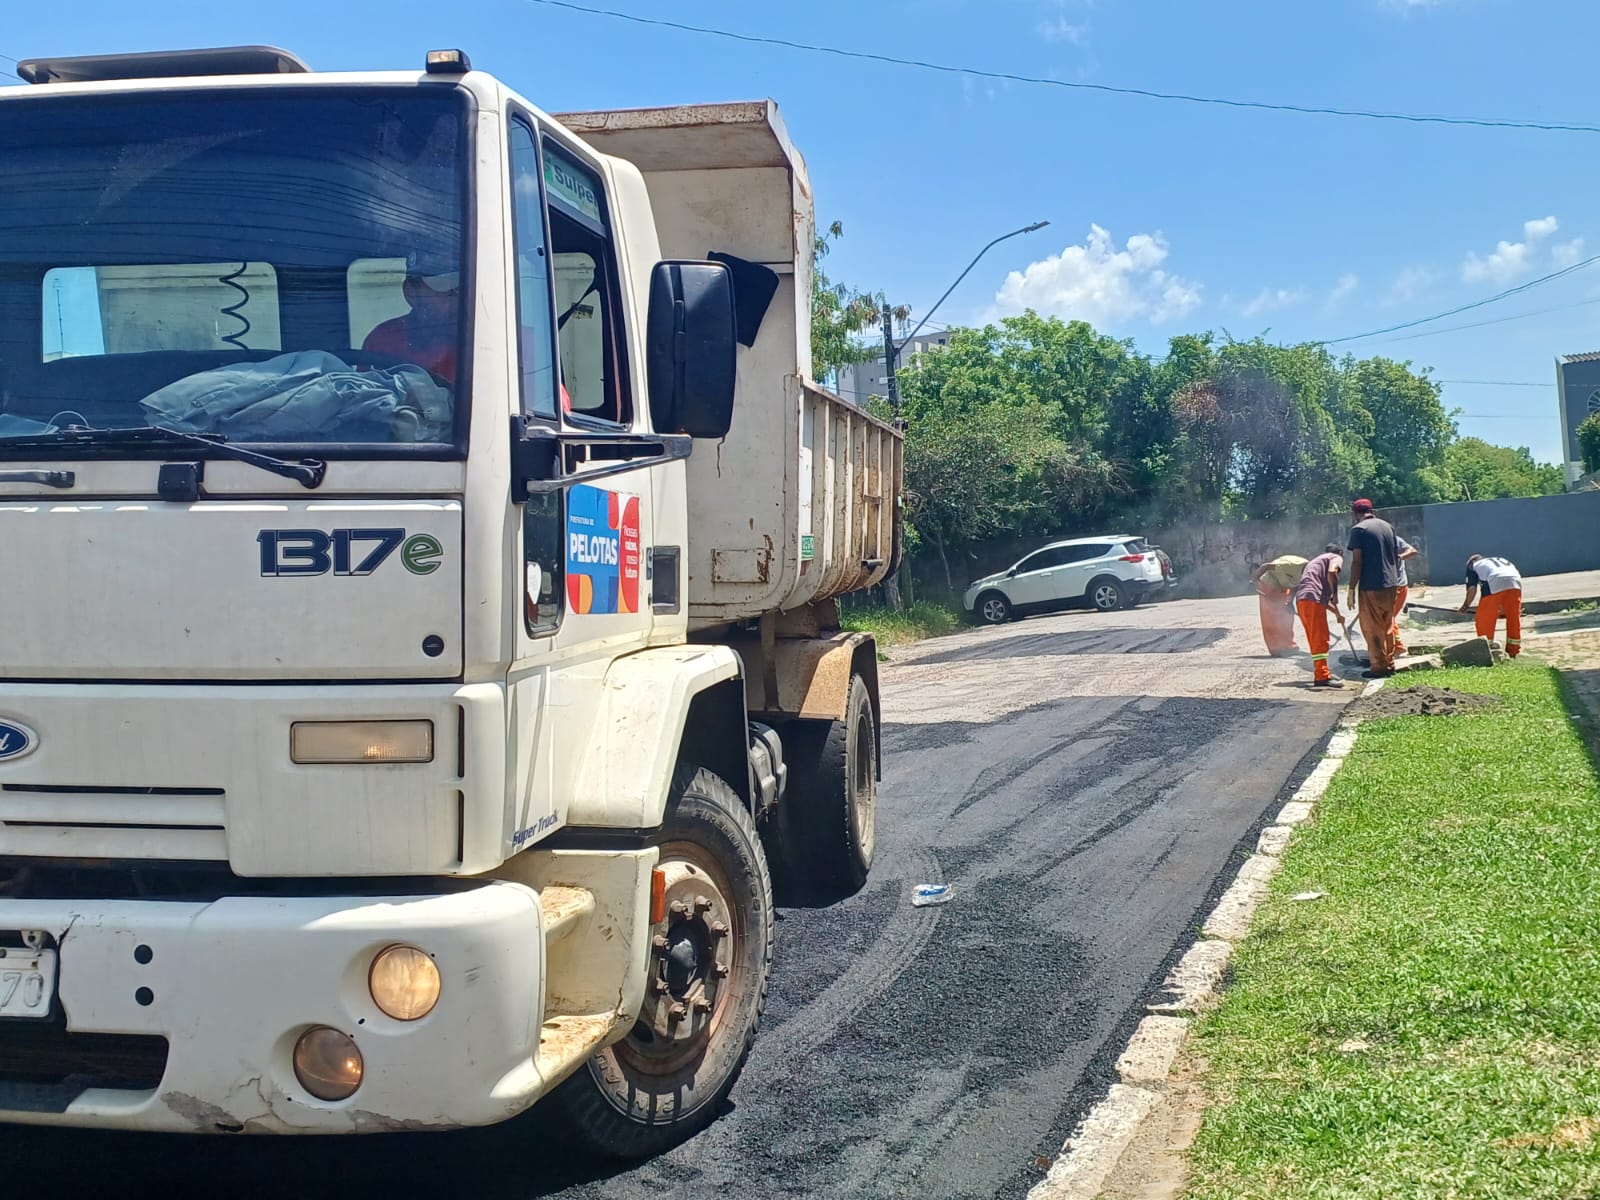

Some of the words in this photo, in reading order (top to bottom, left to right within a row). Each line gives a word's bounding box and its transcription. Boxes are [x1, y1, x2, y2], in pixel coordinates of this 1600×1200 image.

[569, 533, 618, 566] PELOTAS
[512, 823, 538, 848] Super
[537, 808, 560, 833] Truck
